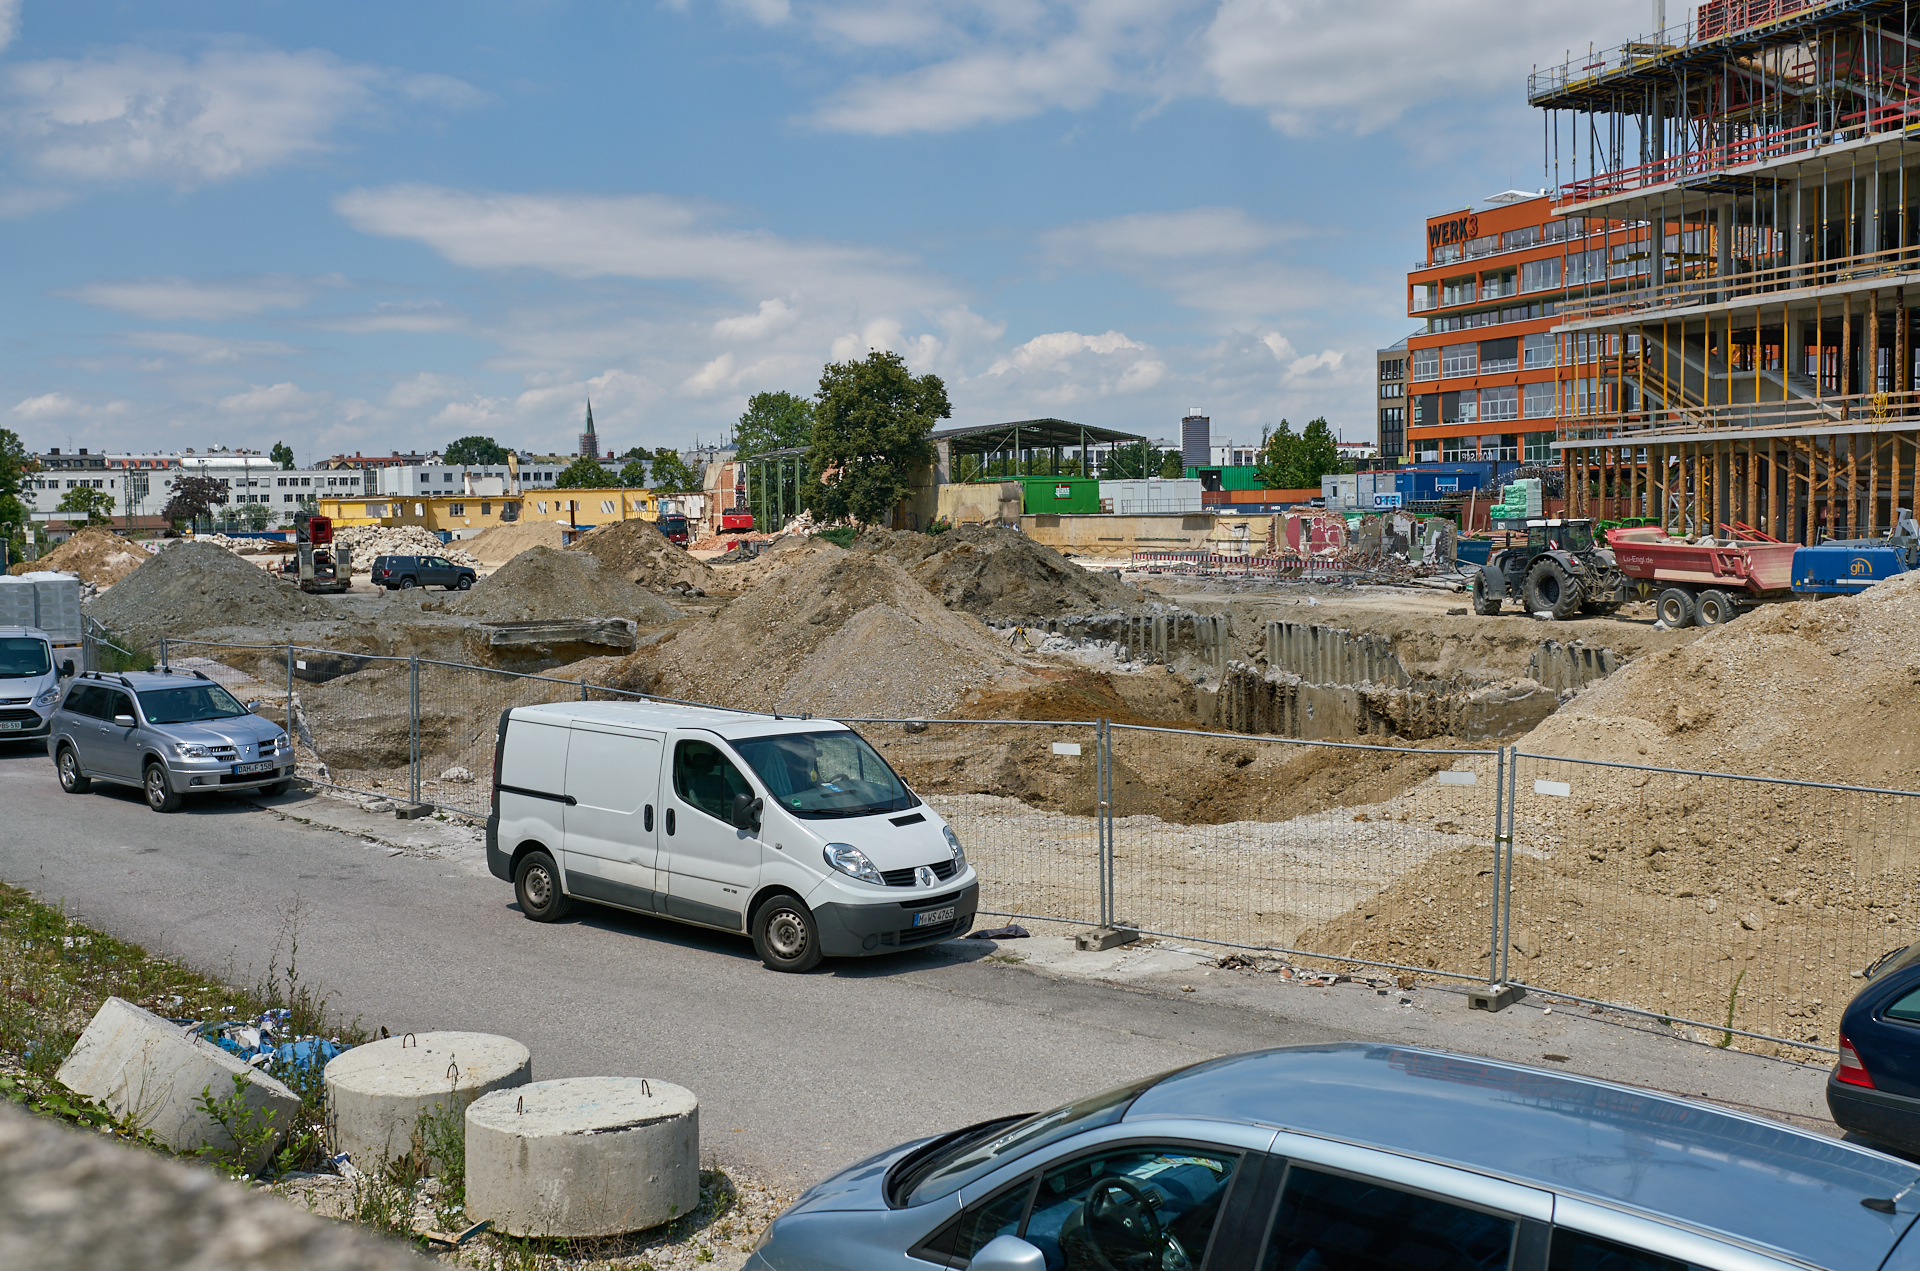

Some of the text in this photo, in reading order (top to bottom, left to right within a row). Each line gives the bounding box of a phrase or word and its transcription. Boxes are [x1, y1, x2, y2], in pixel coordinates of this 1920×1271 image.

[1374, 495, 1401, 505] ORTNER
[1622, 554, 1654, 564] Lu-Engl.de
[1850, 562, 1864, 576] gh
[937, 908, 954, 920] 4765
